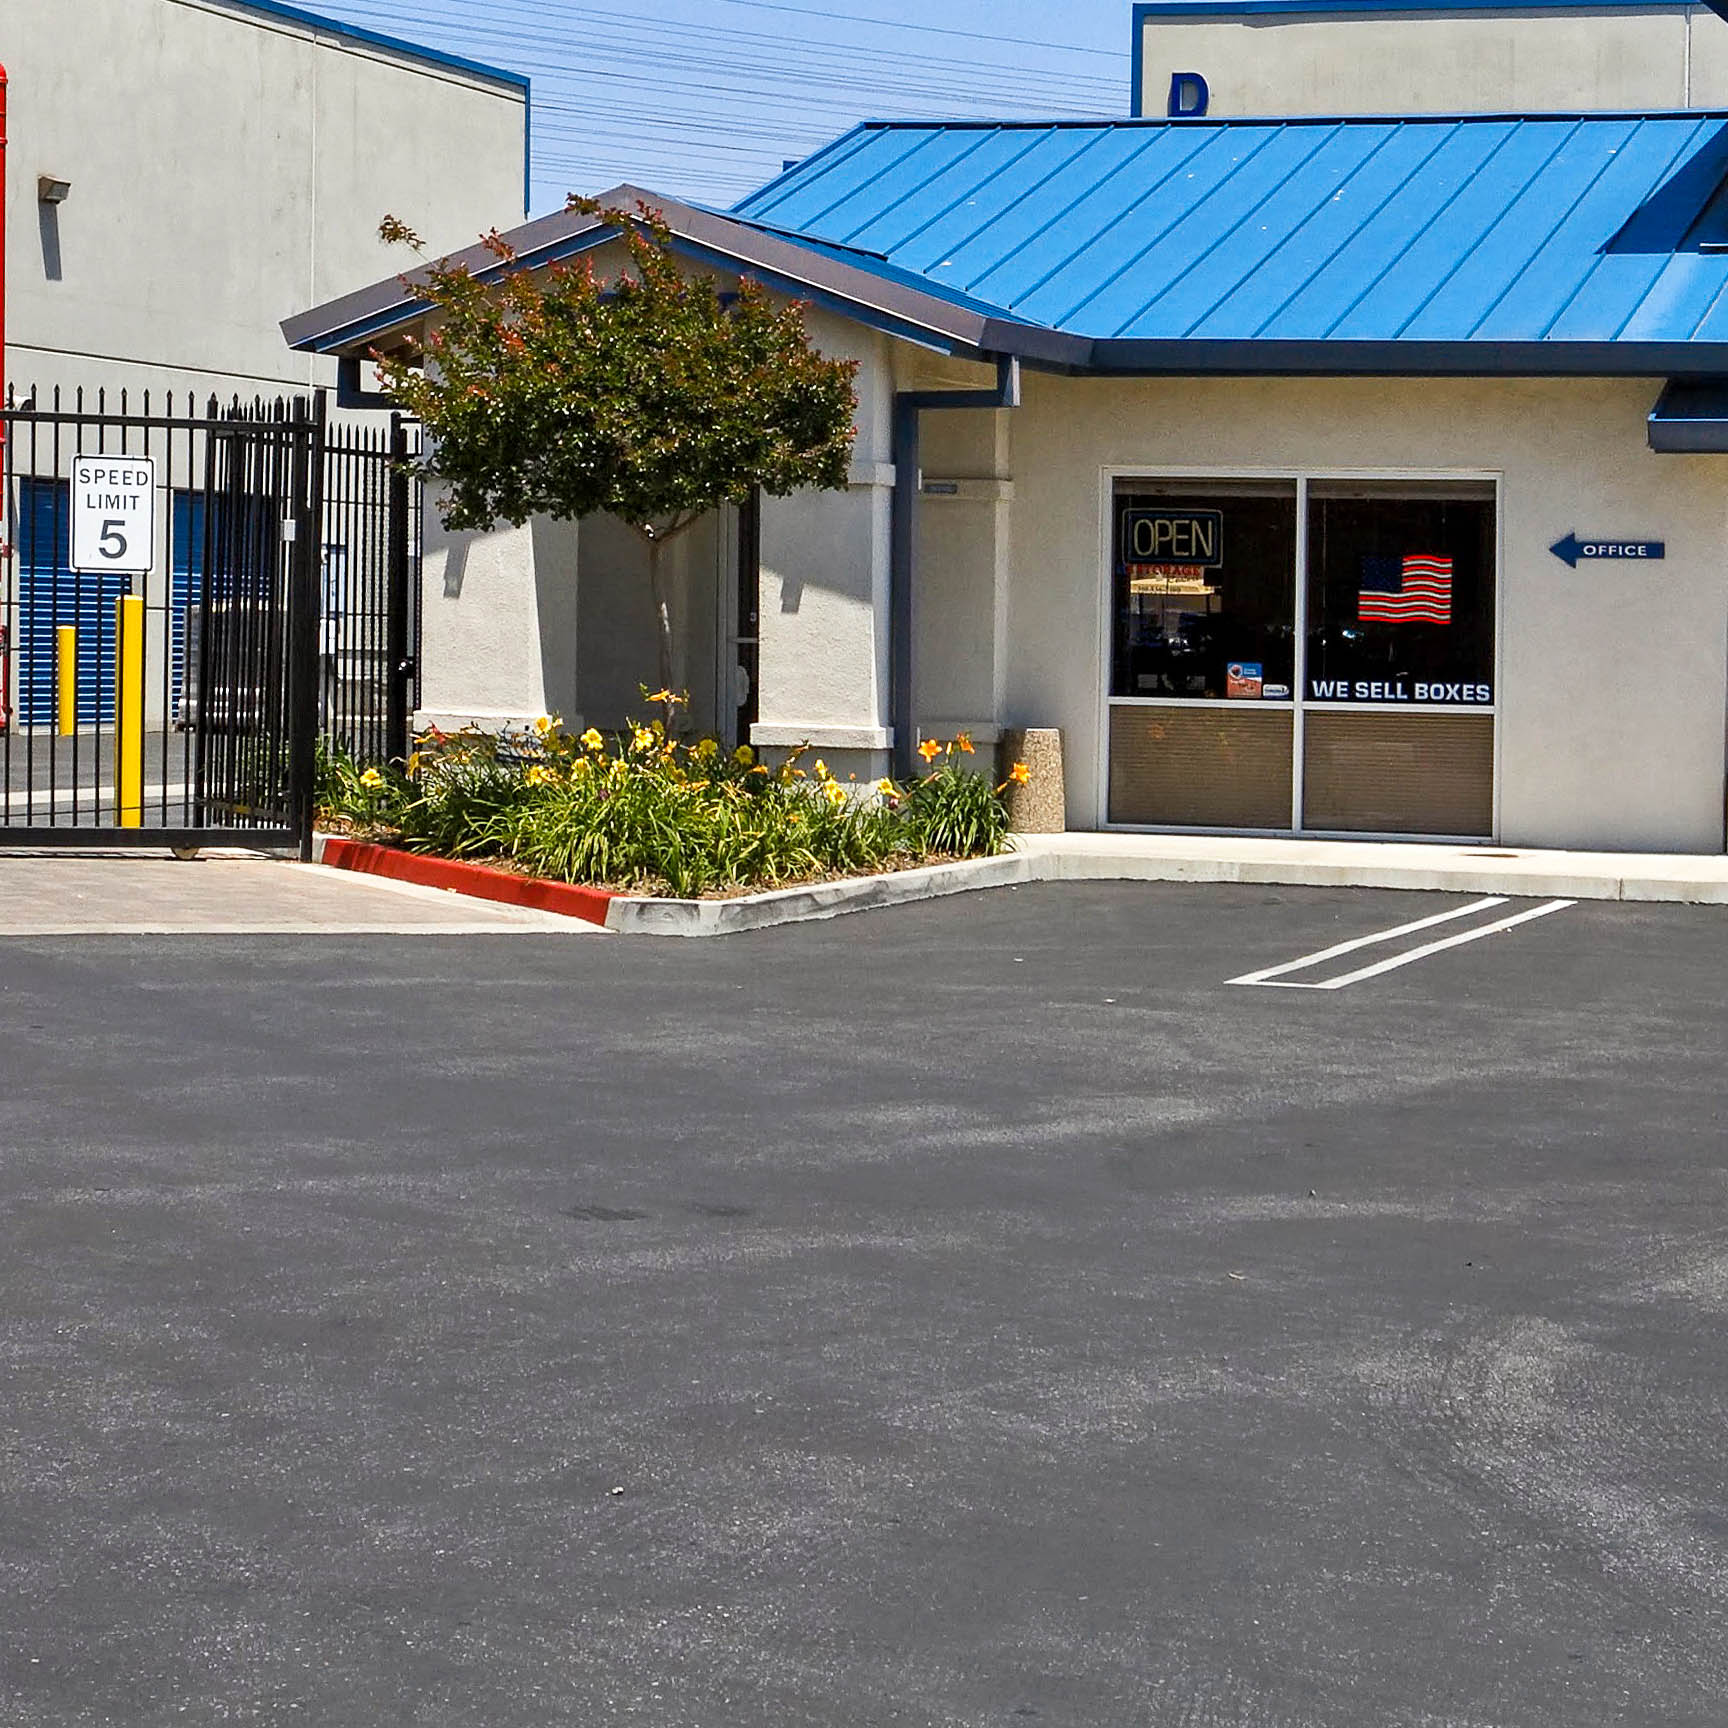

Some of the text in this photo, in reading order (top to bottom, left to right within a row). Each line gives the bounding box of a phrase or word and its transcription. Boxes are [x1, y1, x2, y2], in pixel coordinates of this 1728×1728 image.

[1167, 72, 1210, 118] D
[79, 468, 149, 486] SPEED
[87, 493, 140, 510] LIMIT
[98, 519, 128, 559] 5
[1133, 519, 1214, 558] OPEN
[1583, 545, 1648, 556] OFFICE
[1312, 680, 1491, 702] WE SELL BOXES
